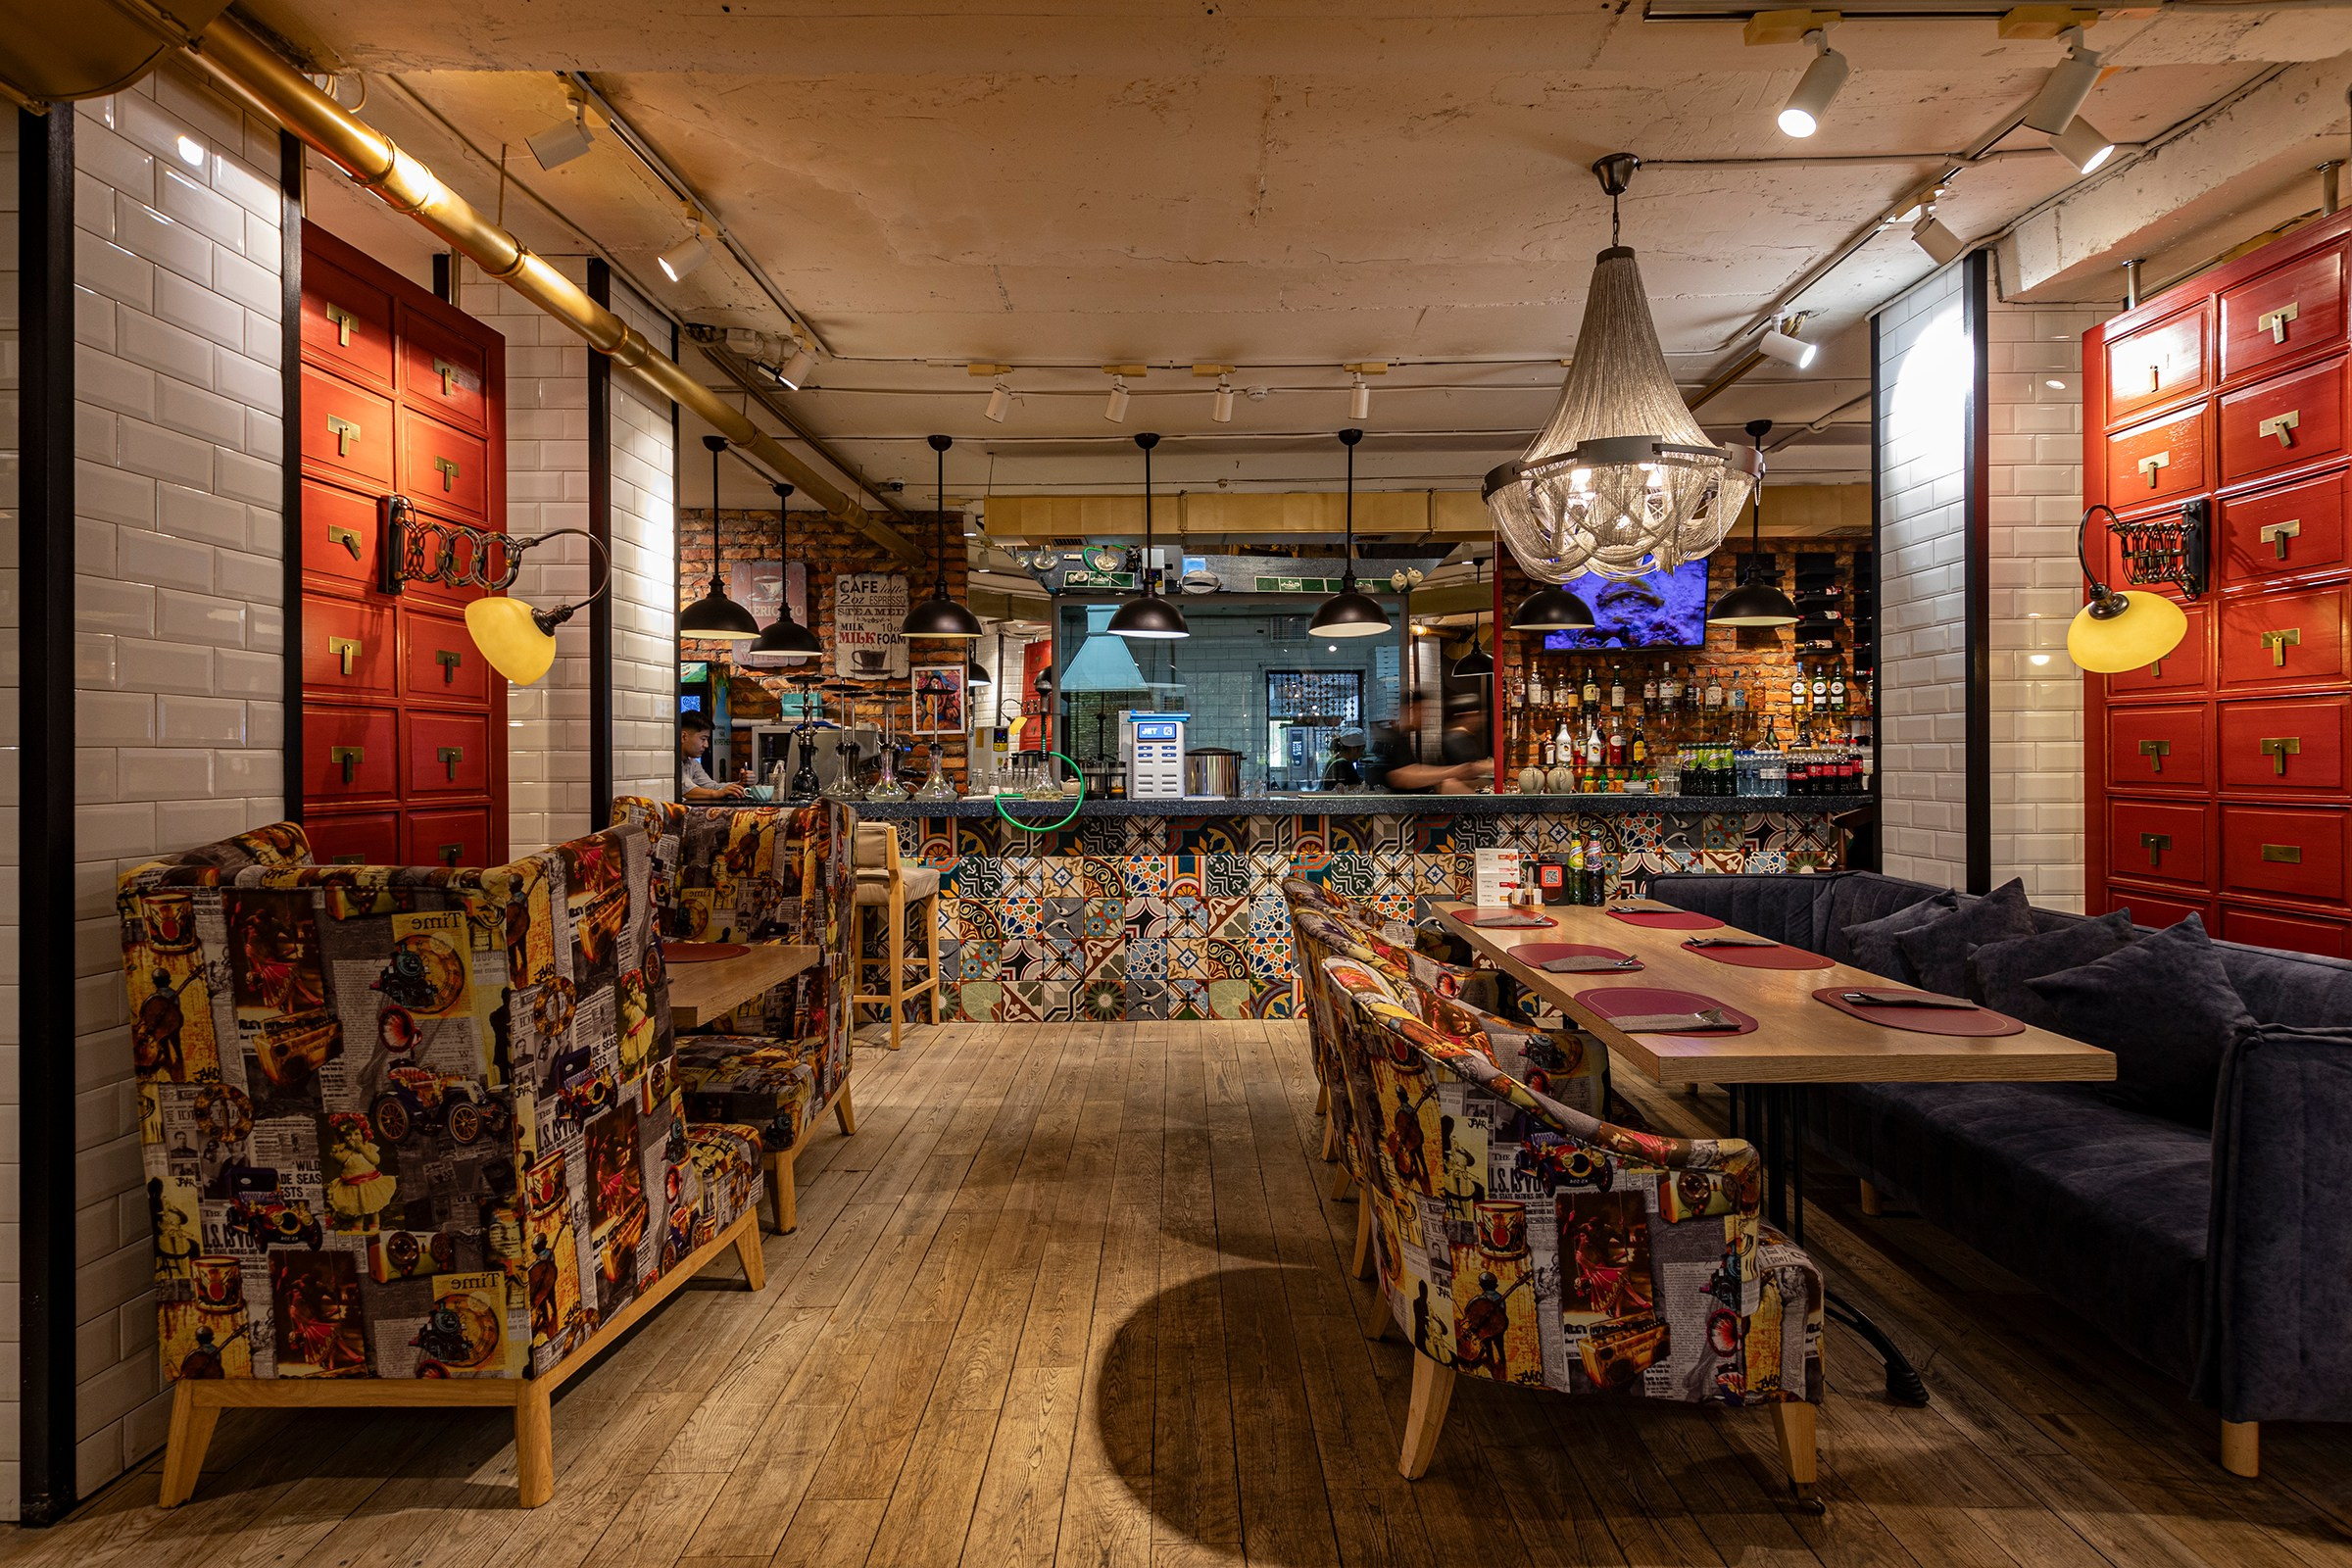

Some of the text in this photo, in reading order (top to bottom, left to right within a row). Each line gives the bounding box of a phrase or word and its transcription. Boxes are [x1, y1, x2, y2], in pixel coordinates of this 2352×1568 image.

[839, 580, 878, 594] CAFE
[869, 596, 906, 605] ESPRESSO
[837, 608, 906, 616] STEAMED
[838, 632, 906, 645] MILK FOAM
